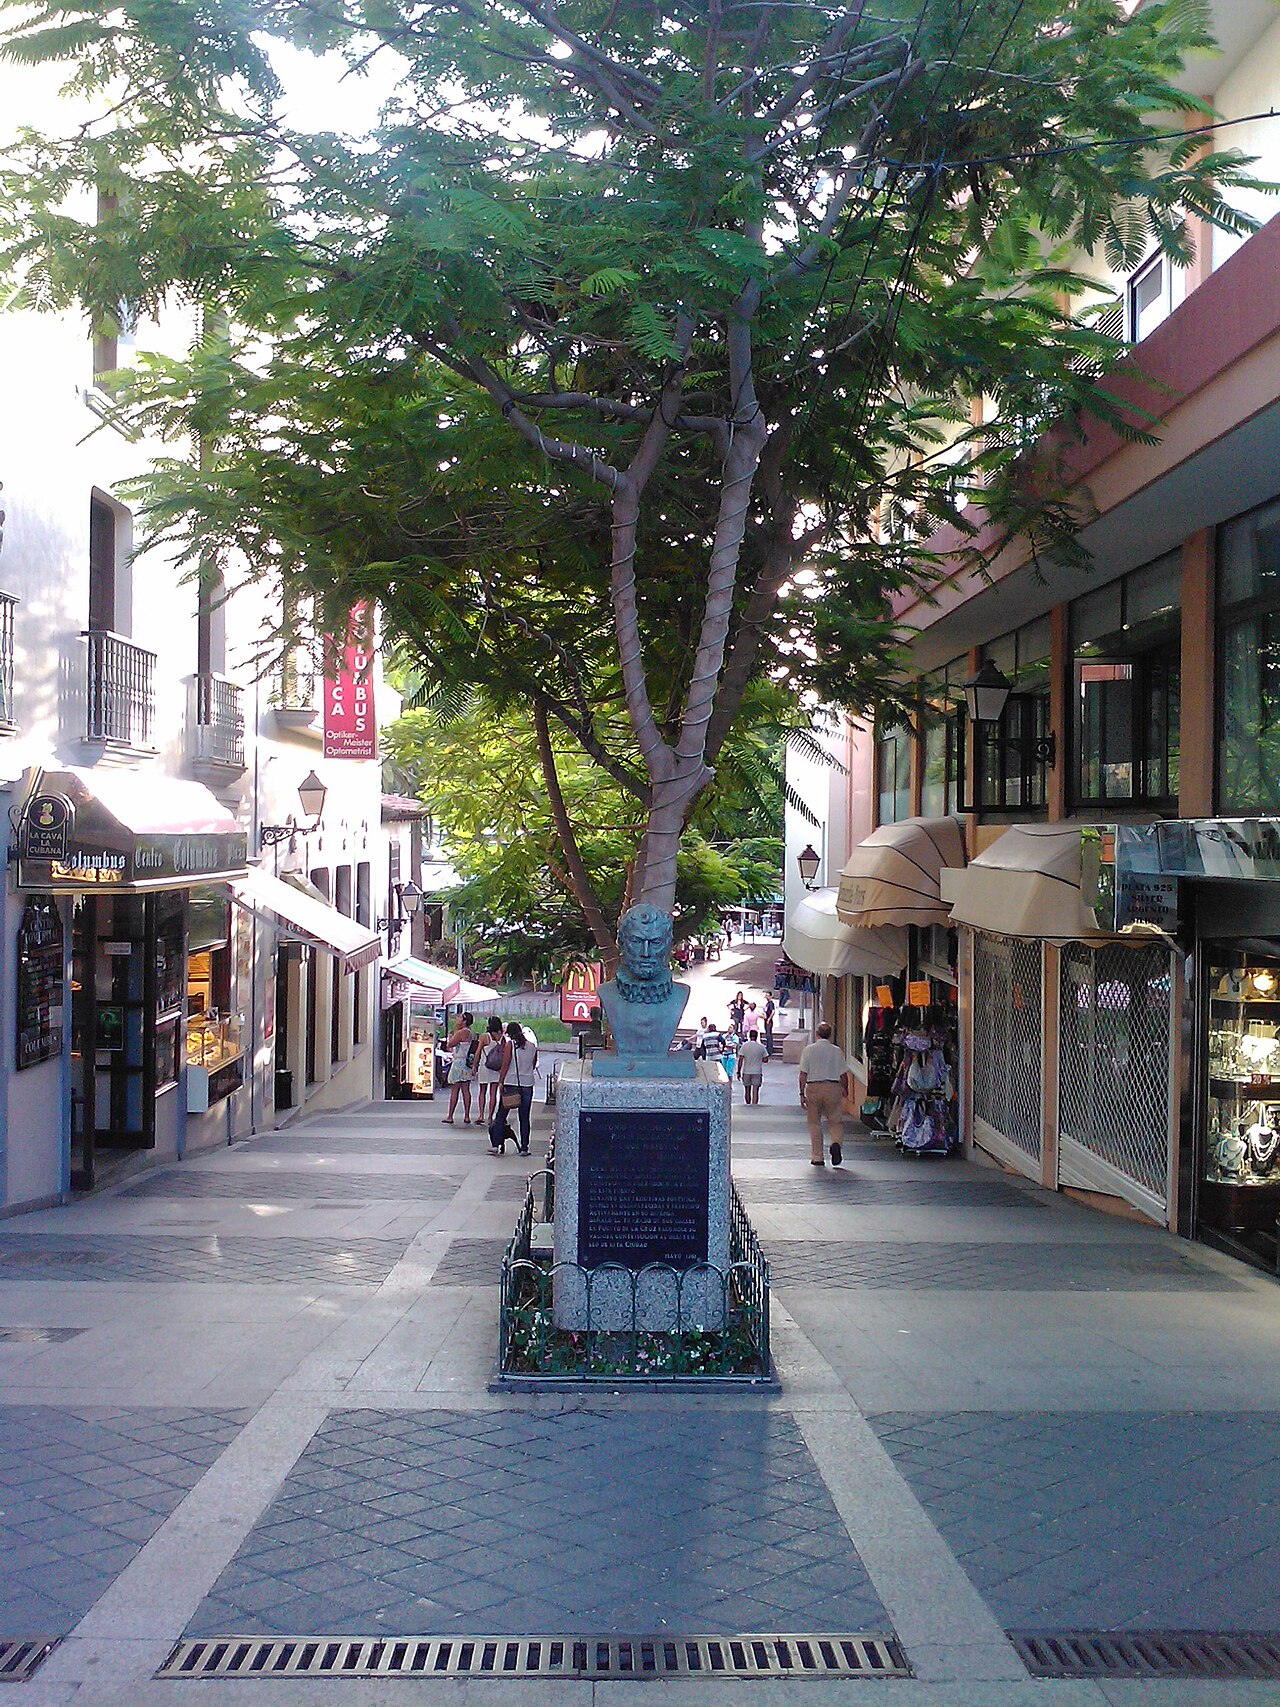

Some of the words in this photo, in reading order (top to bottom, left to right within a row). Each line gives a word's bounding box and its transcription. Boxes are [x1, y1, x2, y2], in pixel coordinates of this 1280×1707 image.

[326, 730, 359, 740] Optiker-
[343, 739, 373, 747] Meister
[326, 746, 372, 756] Optometrist
[30, 832, 40, 840] LA
[40, 832, 63, 841] CAVA
[40, 839, 51, 847] LA
[29, 846, 62, 855] CUBANA
[135, 846, 163, 869] Centro
[173, 838, 218, 873] Columbus
[1121, 883, 1151, 892] PLATA
[1153, 883, 1173, 892] 925
[1132, 893, 1163, 903] SILVER
[1252, 1074, 1262, 1084] 20
